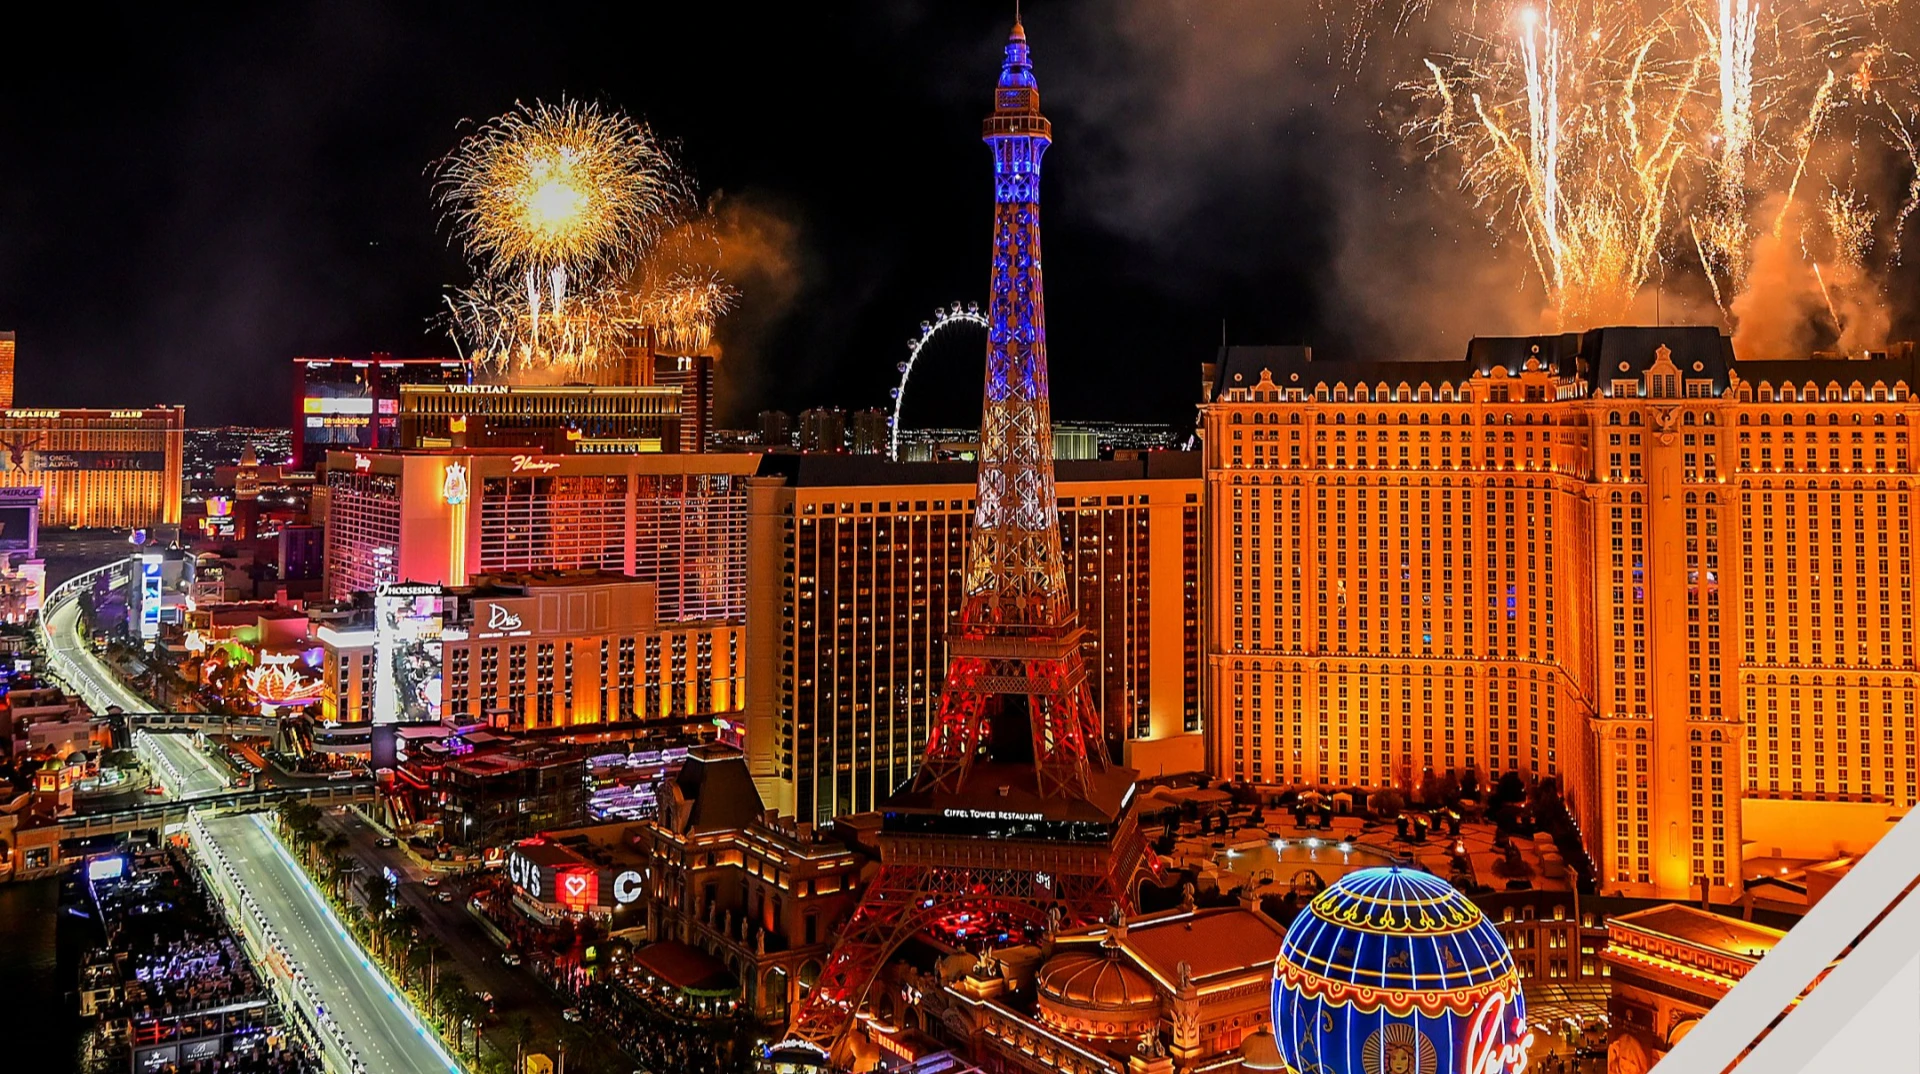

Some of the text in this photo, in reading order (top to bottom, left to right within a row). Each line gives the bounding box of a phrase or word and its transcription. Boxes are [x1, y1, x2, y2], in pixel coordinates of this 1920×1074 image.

[448, 384, 509, 394] VENETIAN
[5, 410, 60, 418] TREASURE
[1, 489, 40, 497] MIRAGE
[387, 586, 443, 595] HORSESHOE
[944, 808, 1043, 821] EIFFEL TOWER RESTAURANT
[509, 851, 541, 897] CVS
[1466, 991, 1534, 1074] Paris
[878, 1033, 913, 1063] BEER PARK
